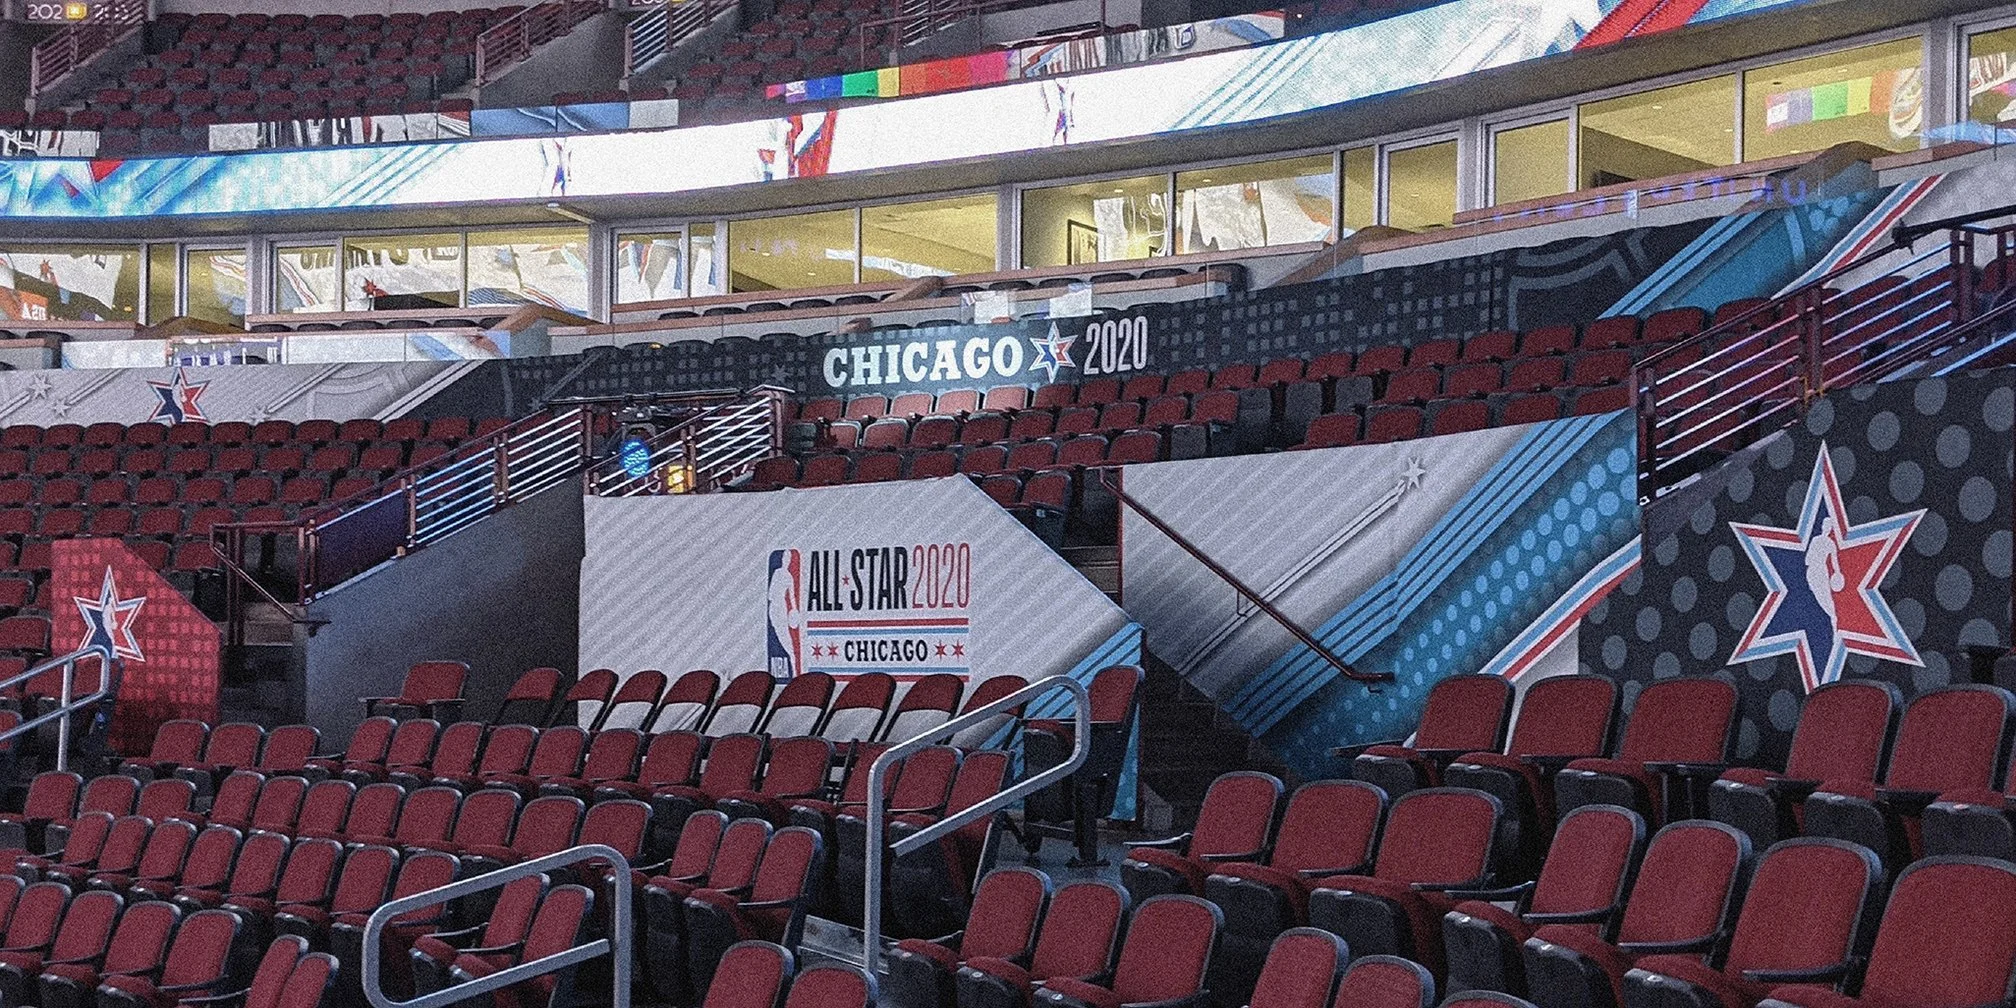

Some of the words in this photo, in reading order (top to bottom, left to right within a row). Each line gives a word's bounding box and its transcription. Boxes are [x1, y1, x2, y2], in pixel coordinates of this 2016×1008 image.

[27, 4, 63, 20] 202
[823, 336, 1024, 388] CHICAGO
[1083, 315, 1149, 376] 2020
[807, 549, 843, 611] ALL
[850, 546, 908, 611] STAR
[912, 543, 971, 609] 2020
[844, 639, 928, 662] CHICAGO
